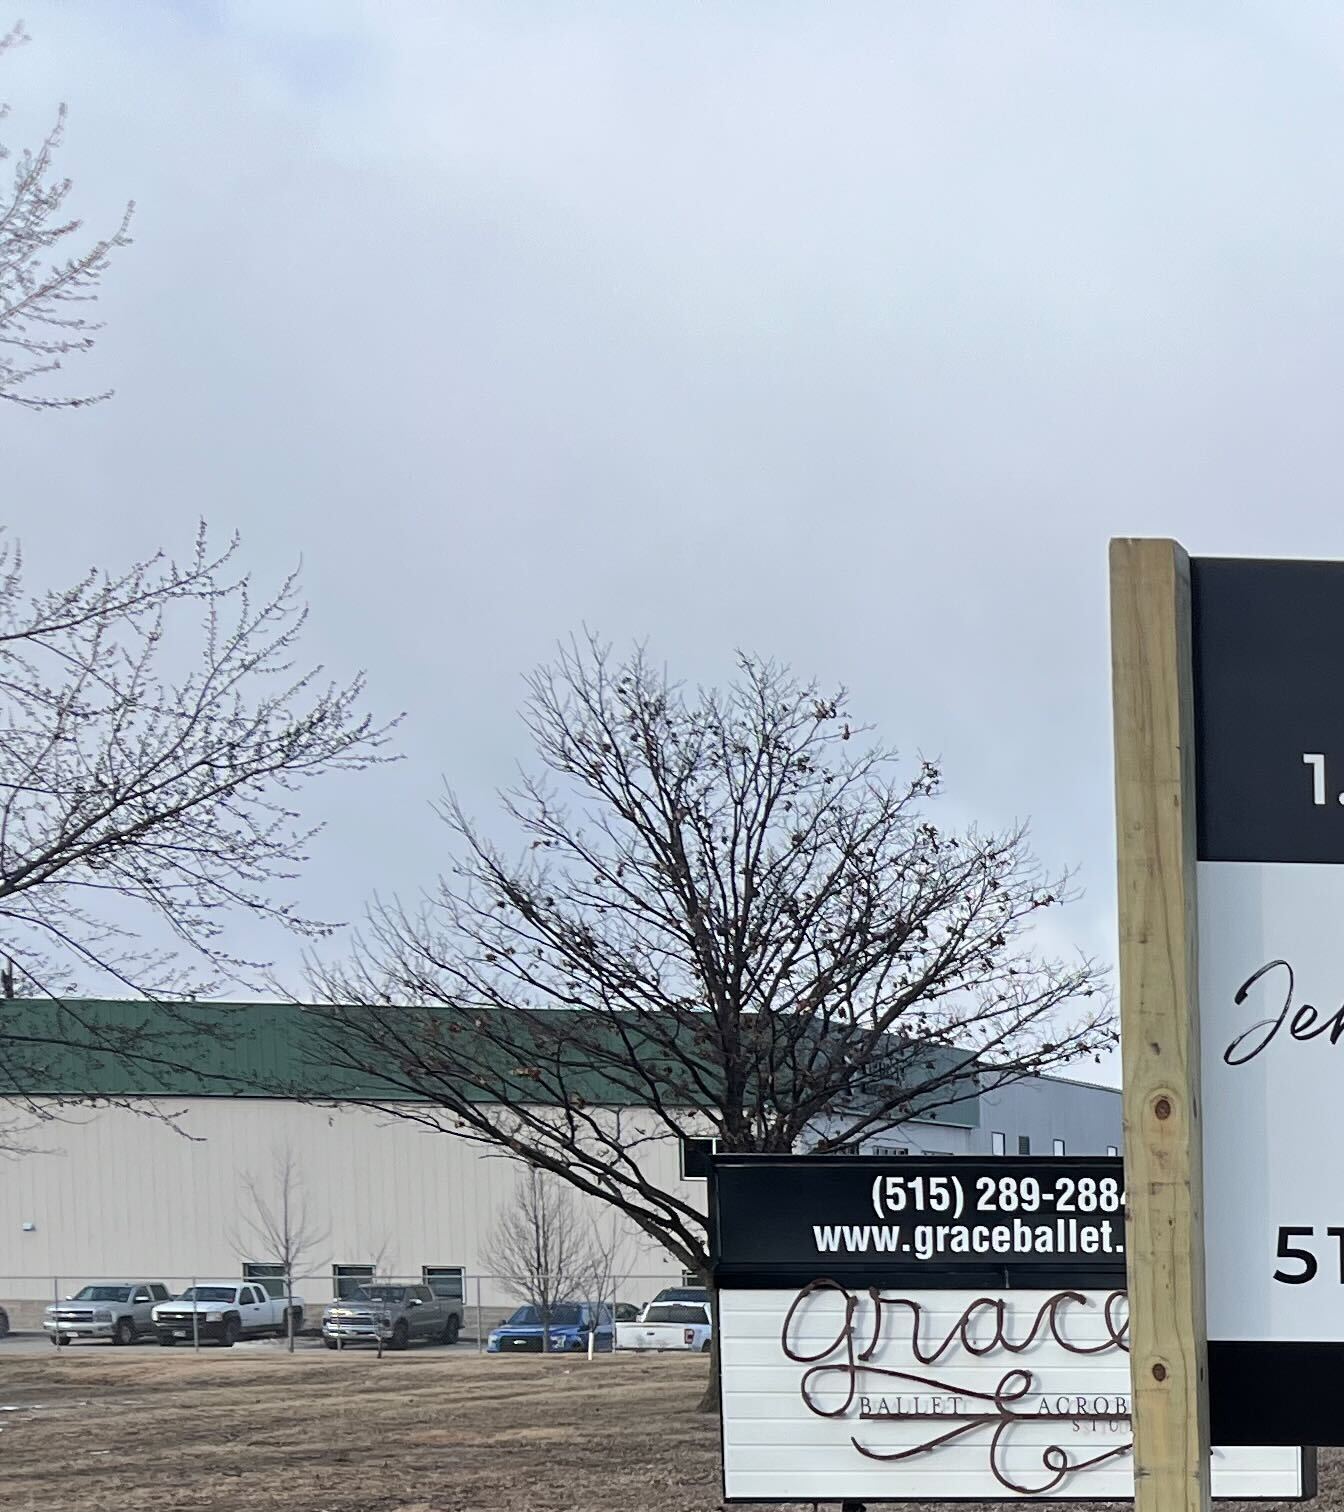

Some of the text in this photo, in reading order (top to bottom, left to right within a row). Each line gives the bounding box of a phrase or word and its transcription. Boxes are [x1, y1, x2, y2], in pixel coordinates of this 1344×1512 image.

[872, 1175, 1126, 1219] (515) 289-288
[812, 1218, 1124, 1260] www.graceballet.
[860, 1396, 1127, 1415] BALLET ACROB
